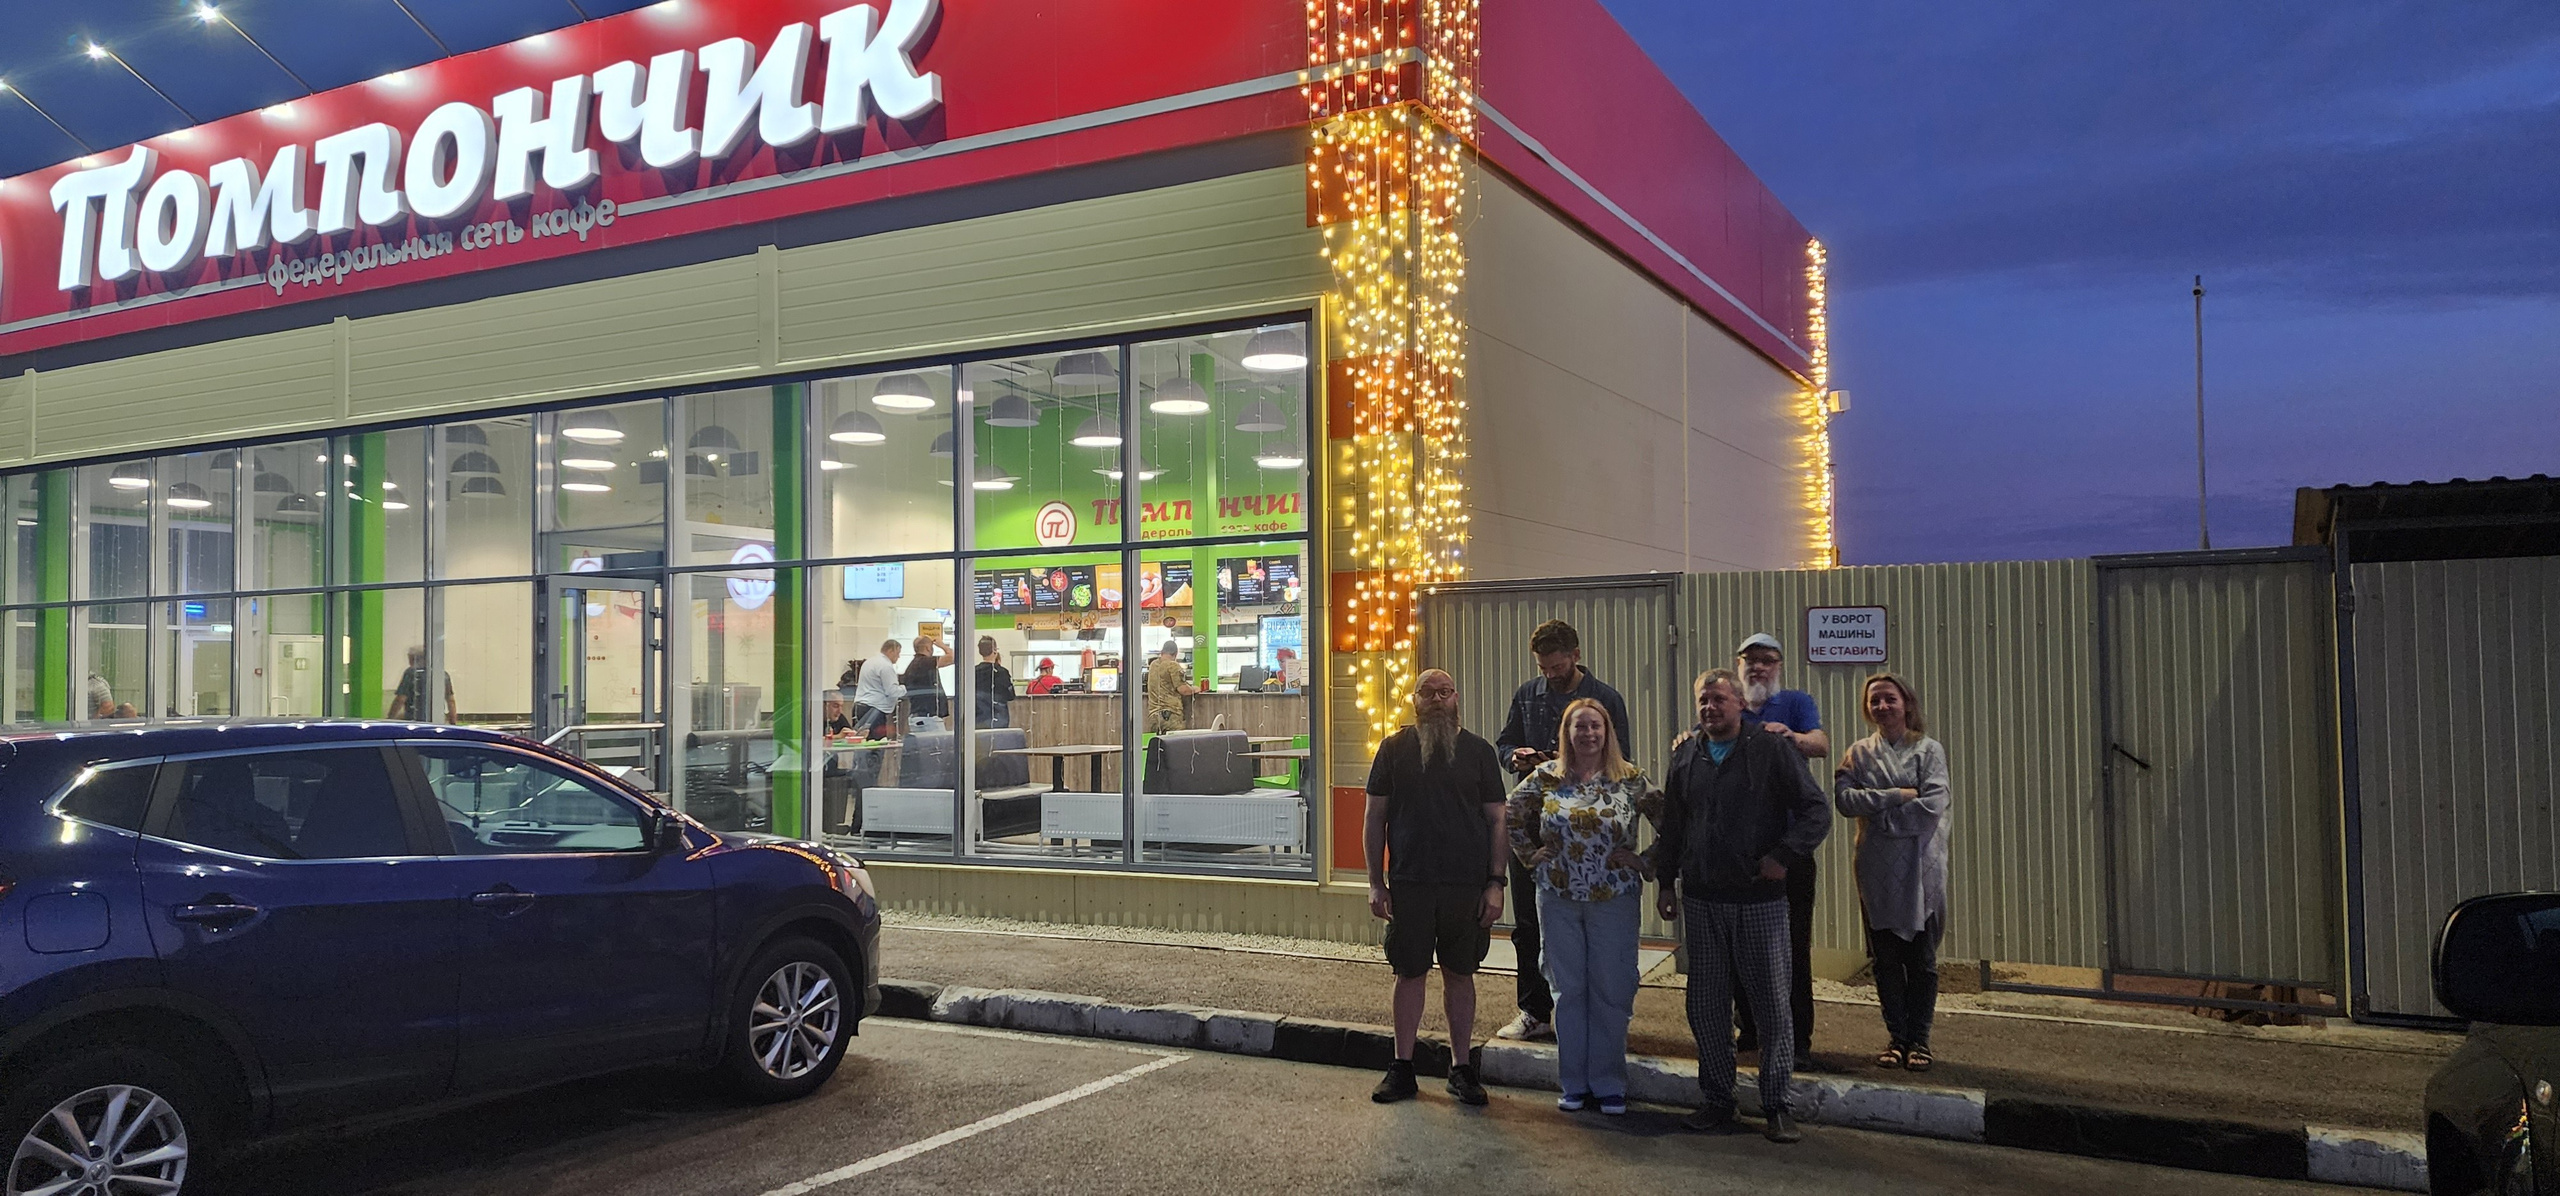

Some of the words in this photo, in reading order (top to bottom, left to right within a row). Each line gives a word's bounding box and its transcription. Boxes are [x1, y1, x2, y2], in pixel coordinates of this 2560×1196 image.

[50, 0, 942, 291] Помпончик
[266, 231, 453, 296] федеральная
[460, 219, 524, 251] сеть
[532, 195, 616, 242] кафе
[1254, 519, 1288, 533] кафе
[1821, 614, 1830, 624] У
[1832, 614, 1873, 624] ВОРОТ
[1818, 629, 1876, 639] МАШИНЫ
[1811, 646, 1827, 656] НЕ
[1829, 646, 1885, 656] СТАВИТЬ
